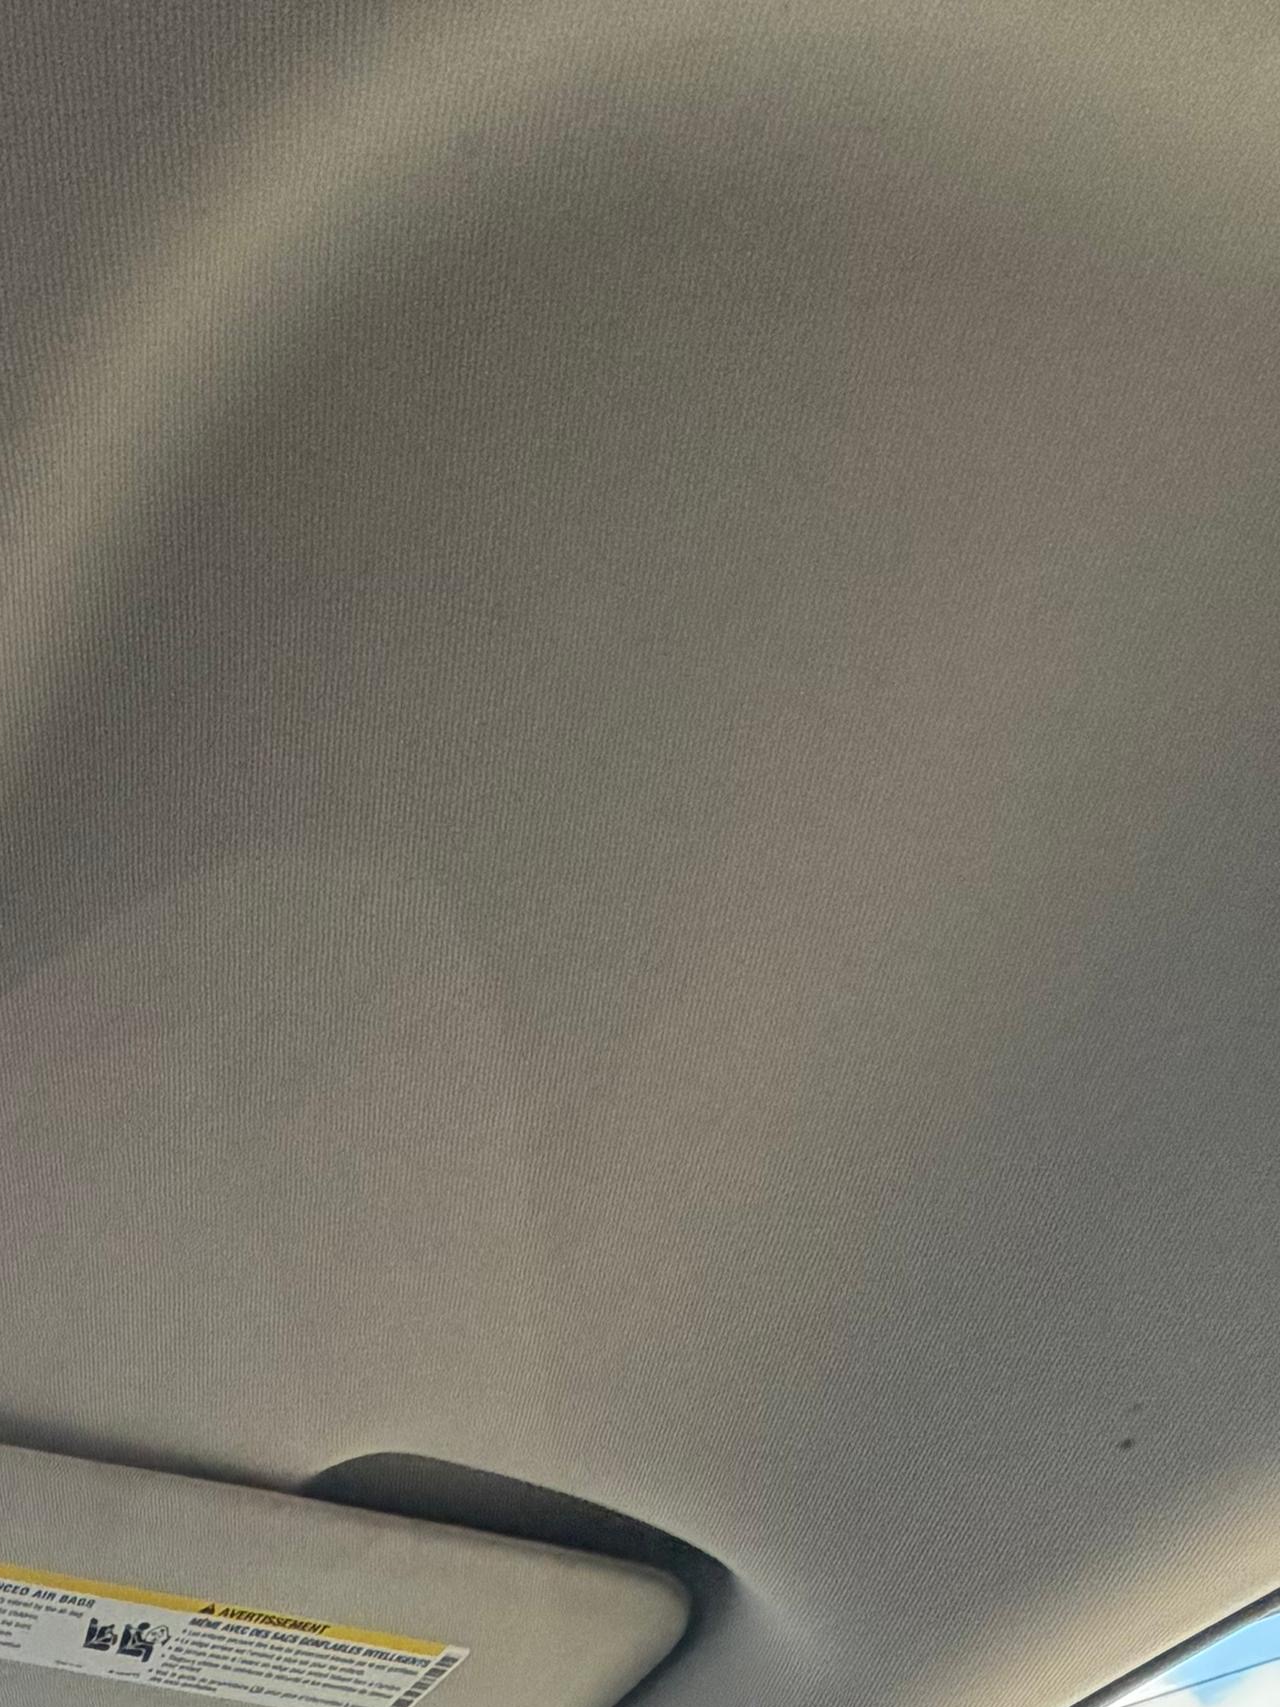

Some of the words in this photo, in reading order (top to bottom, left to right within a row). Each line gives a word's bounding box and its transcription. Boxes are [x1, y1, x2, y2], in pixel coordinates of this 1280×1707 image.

[32, 1589, 57, 1602] AIR
[218, 1606, 332, 1636] AVERTISSEMENT
[221, 1622, 249, 1636] AVEC
